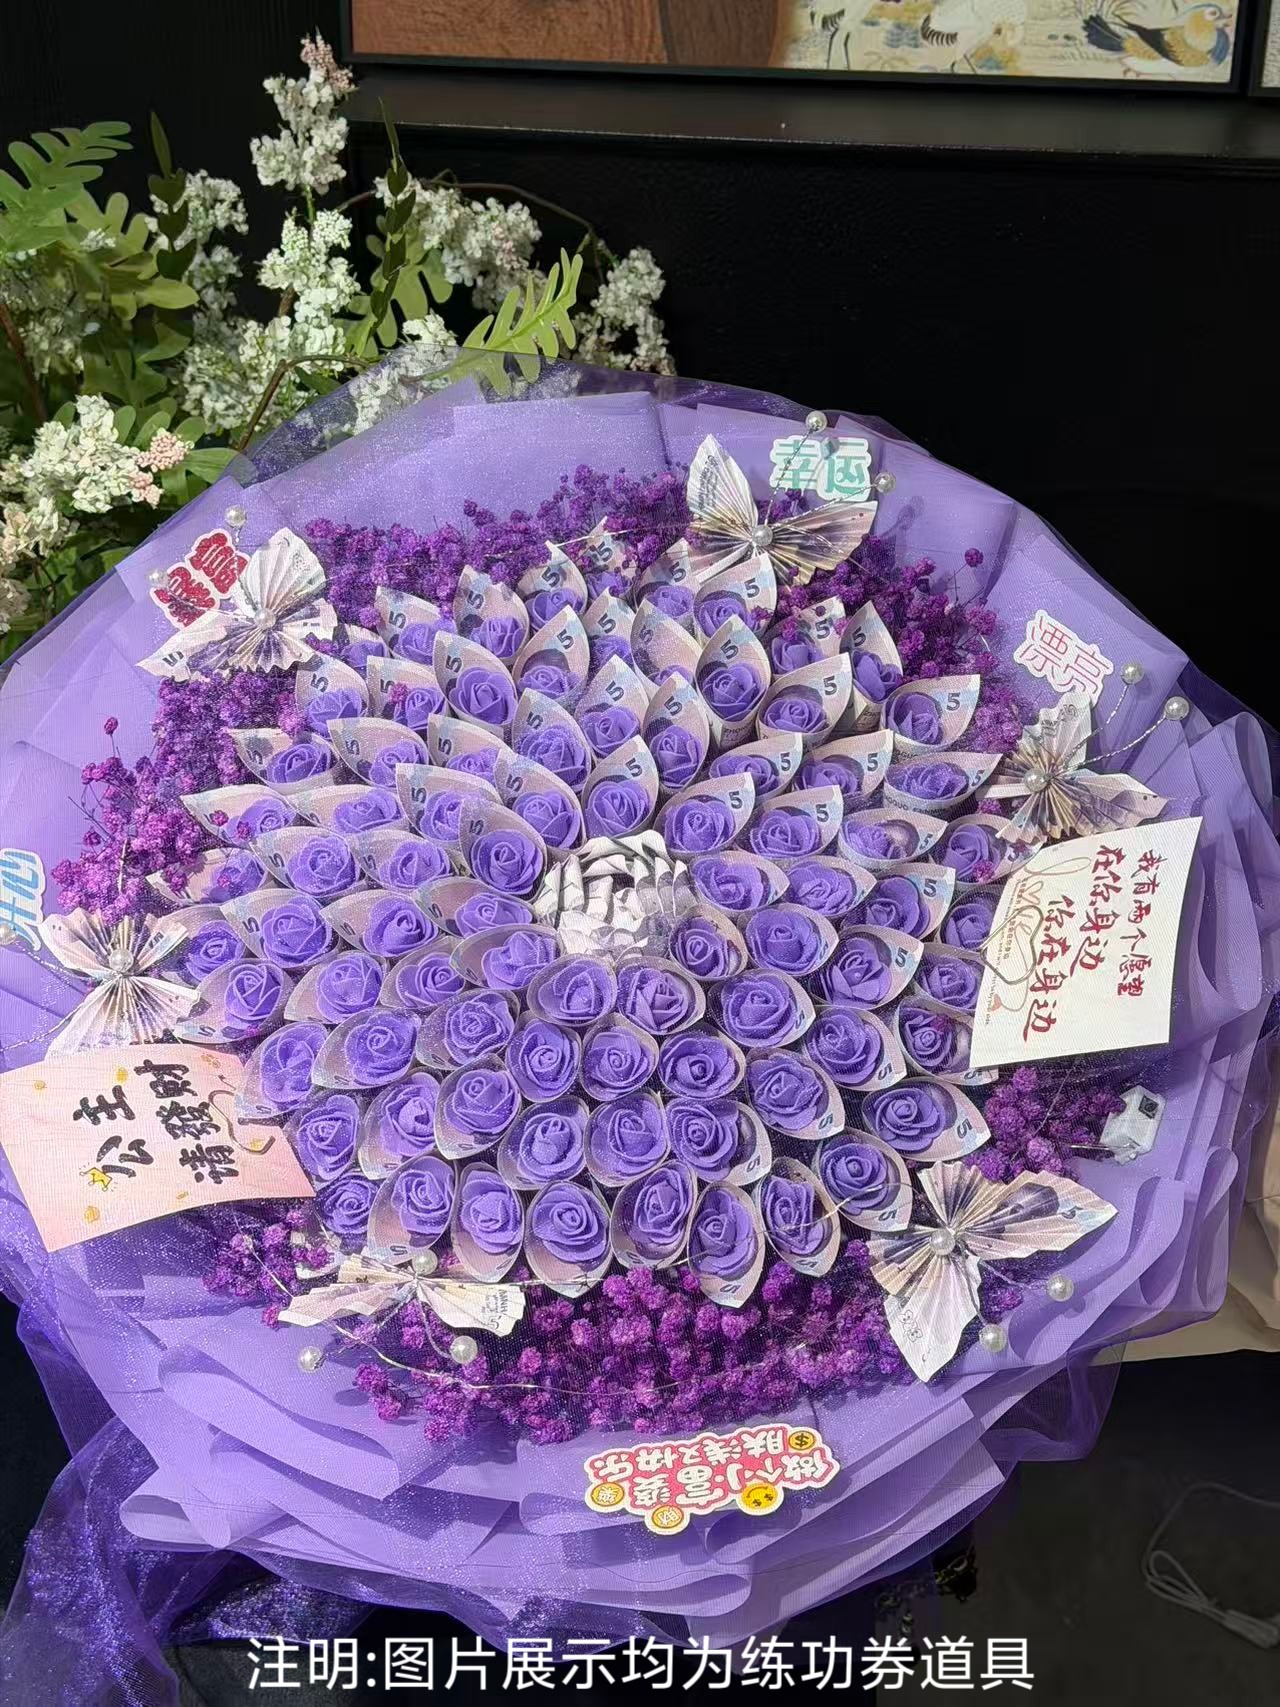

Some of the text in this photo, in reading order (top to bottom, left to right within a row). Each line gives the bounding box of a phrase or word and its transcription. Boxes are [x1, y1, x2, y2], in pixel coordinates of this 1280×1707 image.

[774, 439, 867, 494] 幸运
[598, 542, 613, 562] 5
[542, 566, 560, 588] 5
[668, 562, 686, 582] 5
[744, 578, 760, 598] 5
[468, 590, 484, 610] 5
[389, 611, 406, 628] 5
[599, 614, 616, 633] 5
[816, 619, 830, 639] 5
[556, 629, 575, 650] 5
[852, 628, 867, 646] 5
[721, 640, 739, 660] 5
[1019, 615, 1110, 694] 漂亮
[446, 655, 462, 672] 5
[311, 673, 329, 692] 5
[606, 681, 625, 701] 5
[824, 676, 838, 696] 5
[664, 697, 682, 716] 5
[946, 693, 961, 710] 5
[526, 712, 544, 730] 5
[346, 740, 360, 756] 5
[438, 738, 452, 755] 5
[626, 758, 642, 778] 5
[780, 752, 791, 772] 5
[866, 752, 878, 772] 5
[506, 774, 524, 792] 5
[971, 770, 985, 786] 5
[411, 787, 426, 804] 5
[729, 791, 743, 810] 5
[816, 804, 830, 822] 5
[470, 820, 484, 836] 5
[269, 853, 284, 868] 5
[363, 854, 376, 869] 5
[924, 879, 937, 898] 5
[428, 903, 443, 918] 5
[1069, 845, 1128, 977] 在你身边
[242, 916, 260, 934] 5
[895, 947, 909, 968] 5
[1023, 894, 1075, 1042] 你在身边
[198, 1025, 216, 1038] 5
[878, 1063, 893, 1080] 5
[818, 1115, 834, 1130] 5
[956, 1118, 972, 1138] 5
[746, 1154, 760, 1172] 5
[879, 1210, 898, 1223] 5
[721, 1284, 742, 1294] 5
[594, 1430, 784, 1482] 肤浅又快乐
[633, 1450, 829, 1505] 做个小富婆
